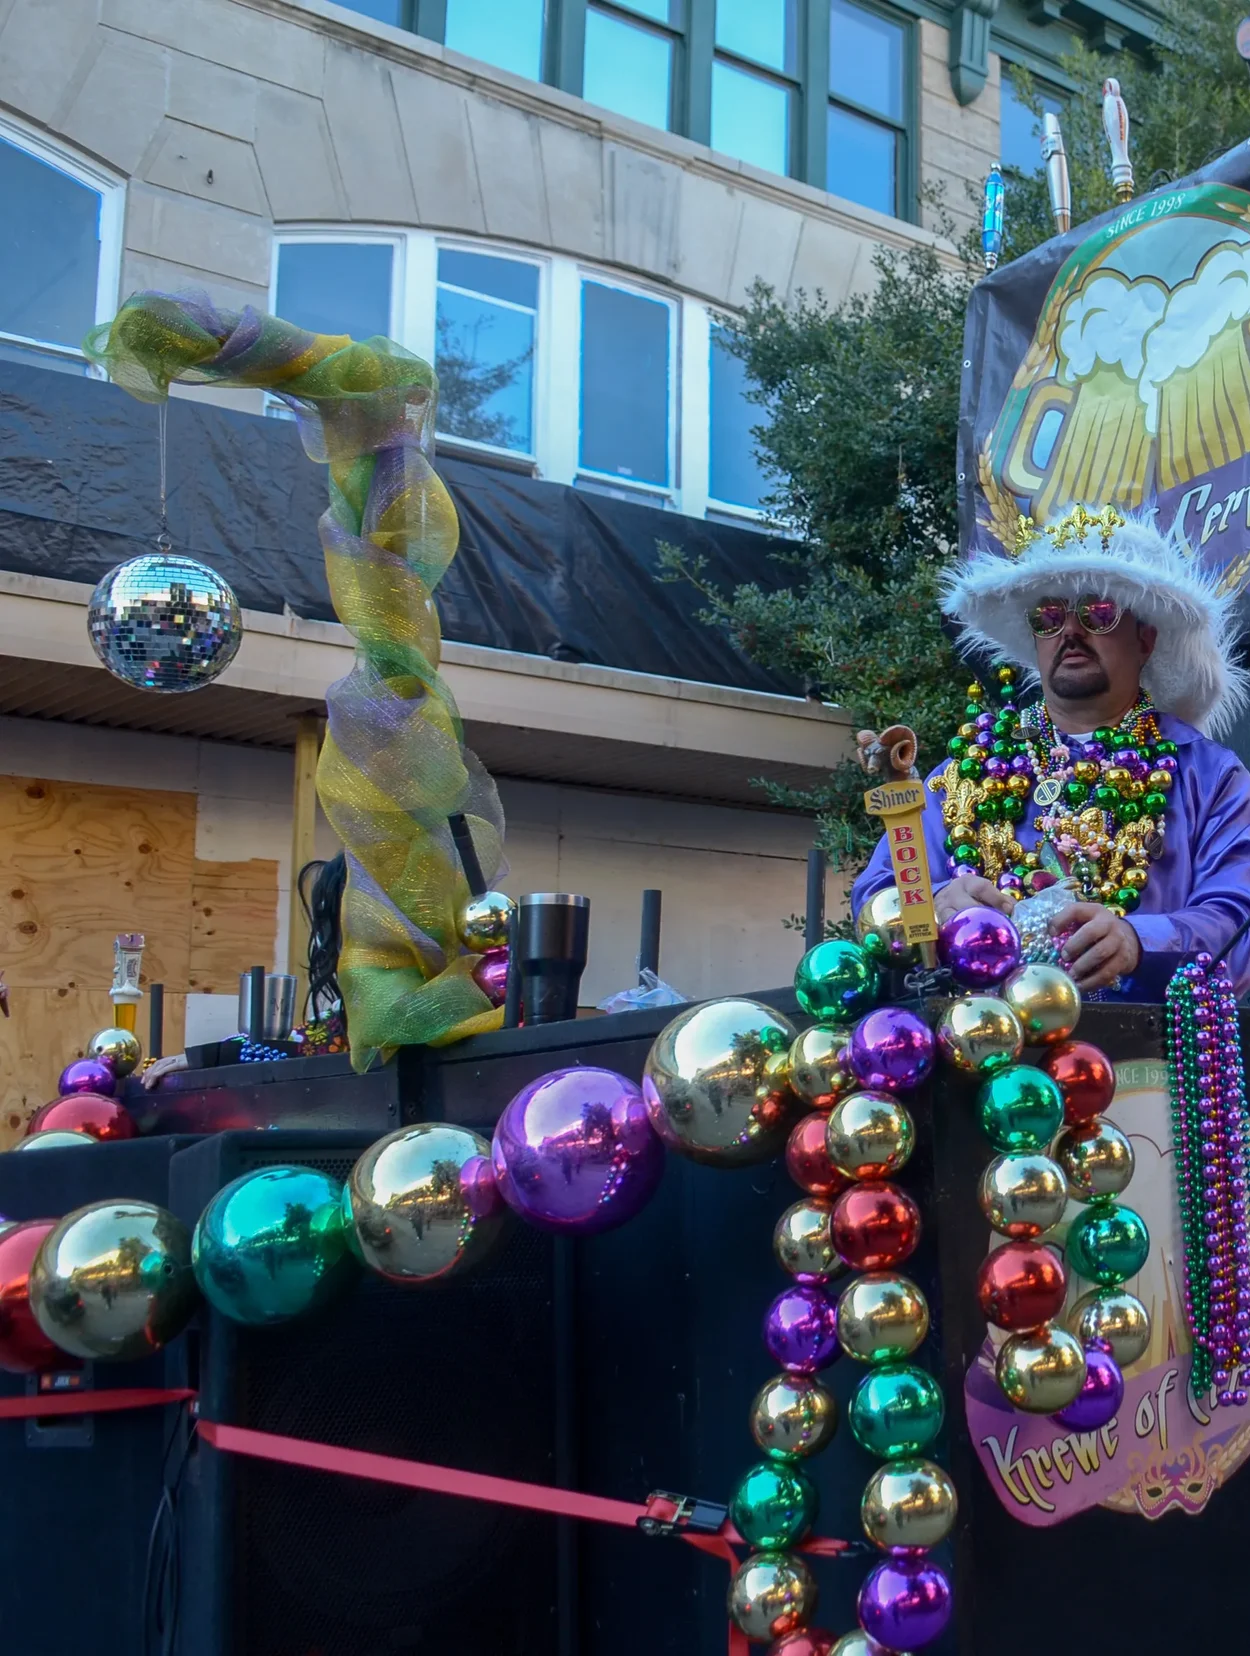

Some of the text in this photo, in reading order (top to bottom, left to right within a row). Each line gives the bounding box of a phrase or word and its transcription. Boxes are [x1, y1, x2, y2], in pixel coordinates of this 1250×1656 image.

[1150, 192, 1187, 218] 1998
[869, 788, 920, 811] Shiner
[892, 826, 928, 906] BOCK
[1115, 1066, 1169, 1086] NCE 199
[981, 1417, 1120, 1512] Krewe
[1134, 1369, 1179, 1450] of
